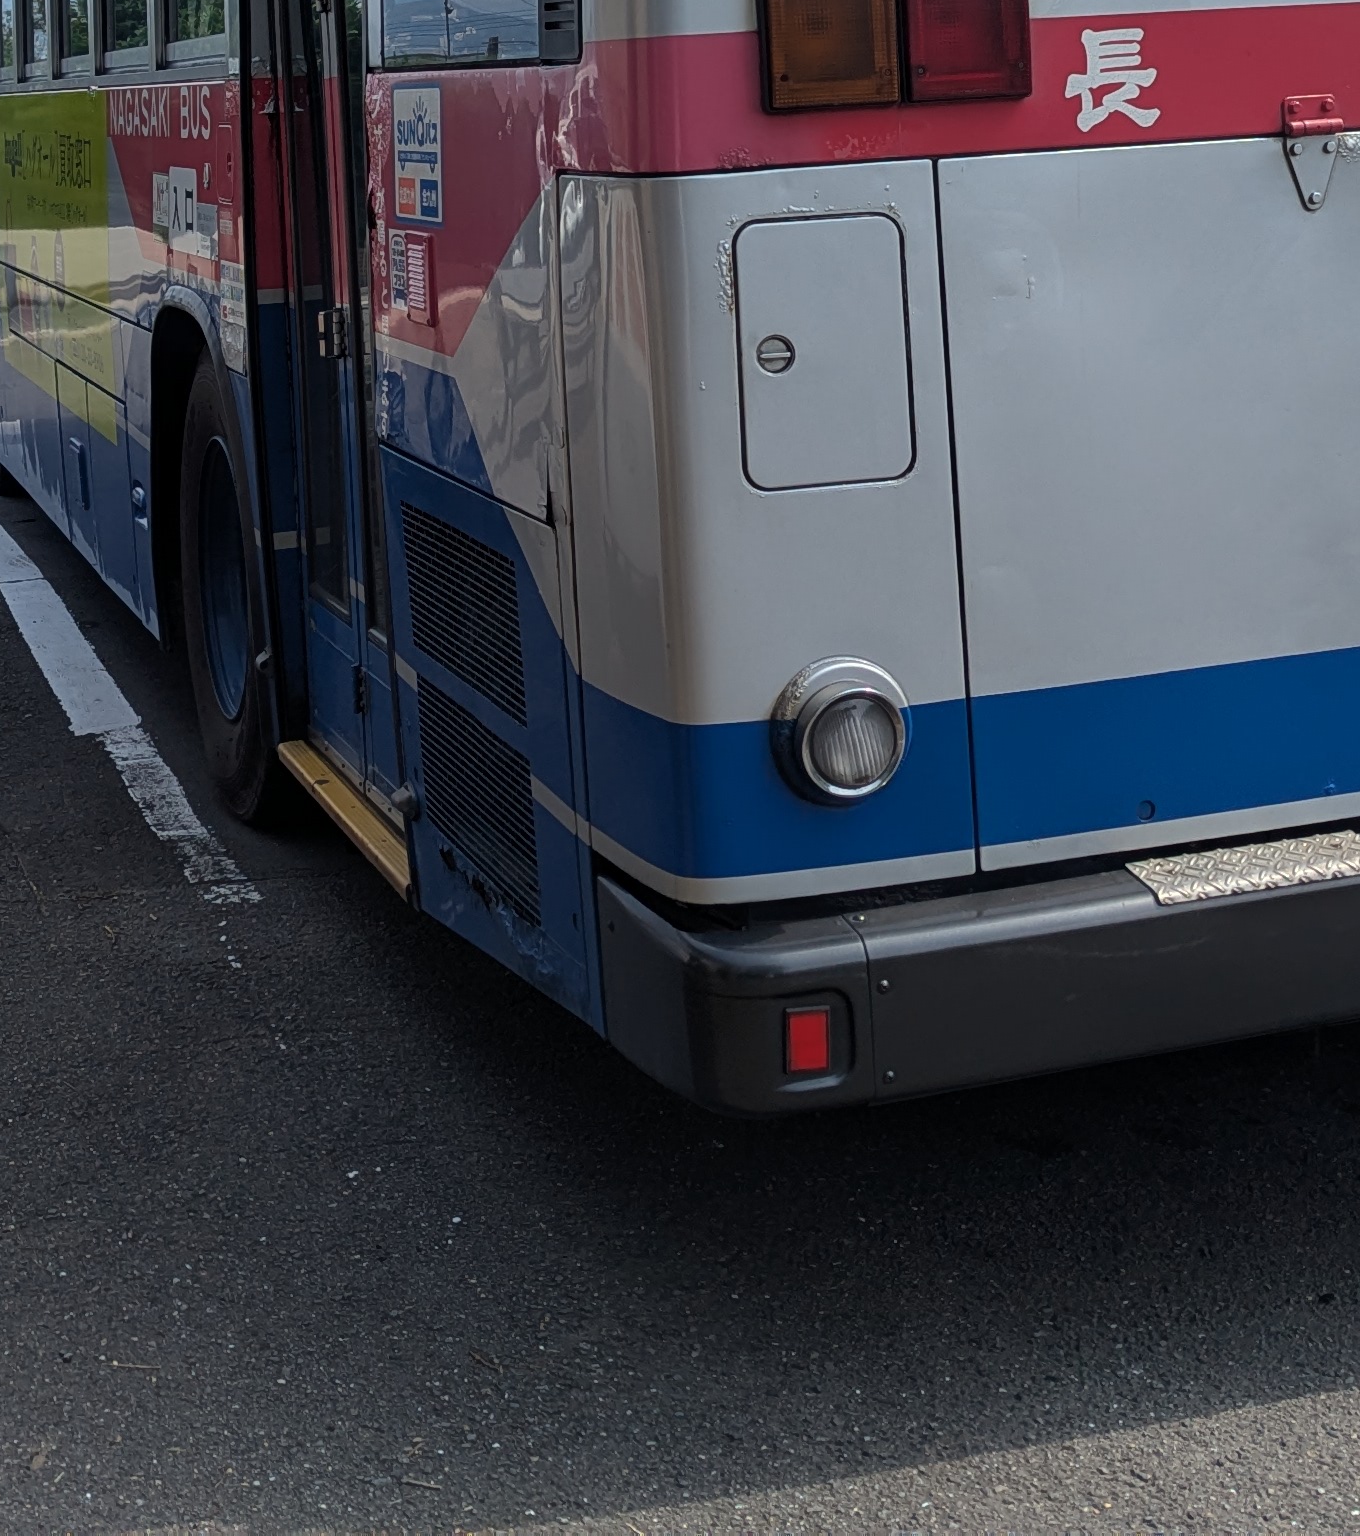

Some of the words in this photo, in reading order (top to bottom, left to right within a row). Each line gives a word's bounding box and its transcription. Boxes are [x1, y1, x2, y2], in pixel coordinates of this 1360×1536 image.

[109, 86, 170, 139] NAGASAKI
[180, 85, 211, 140] BUS
[171, 185, 194, 234] 入口
